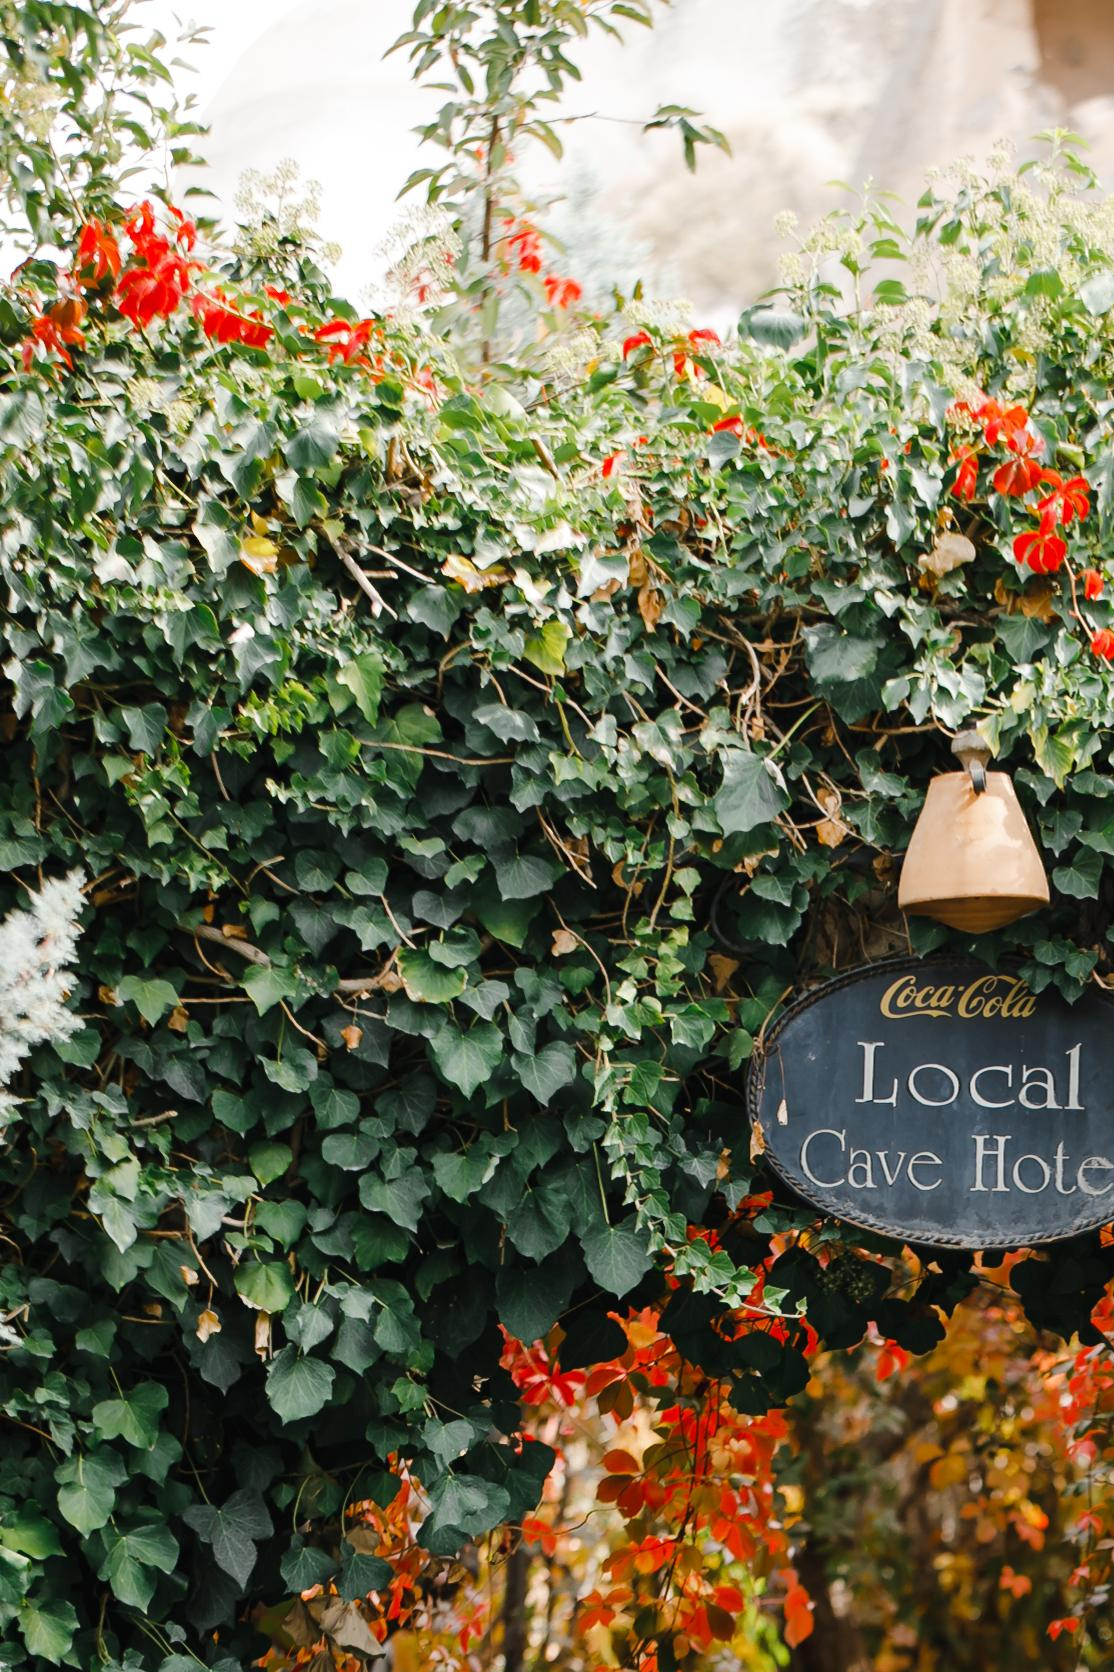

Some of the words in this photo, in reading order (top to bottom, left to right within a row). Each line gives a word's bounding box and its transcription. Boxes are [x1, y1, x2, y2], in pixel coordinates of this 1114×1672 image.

[880, 975, 1037, 1018] Coca-Cola
[855, 1041, 1085, 1110] Local
[801, 1129, 943, 1191] Cave
